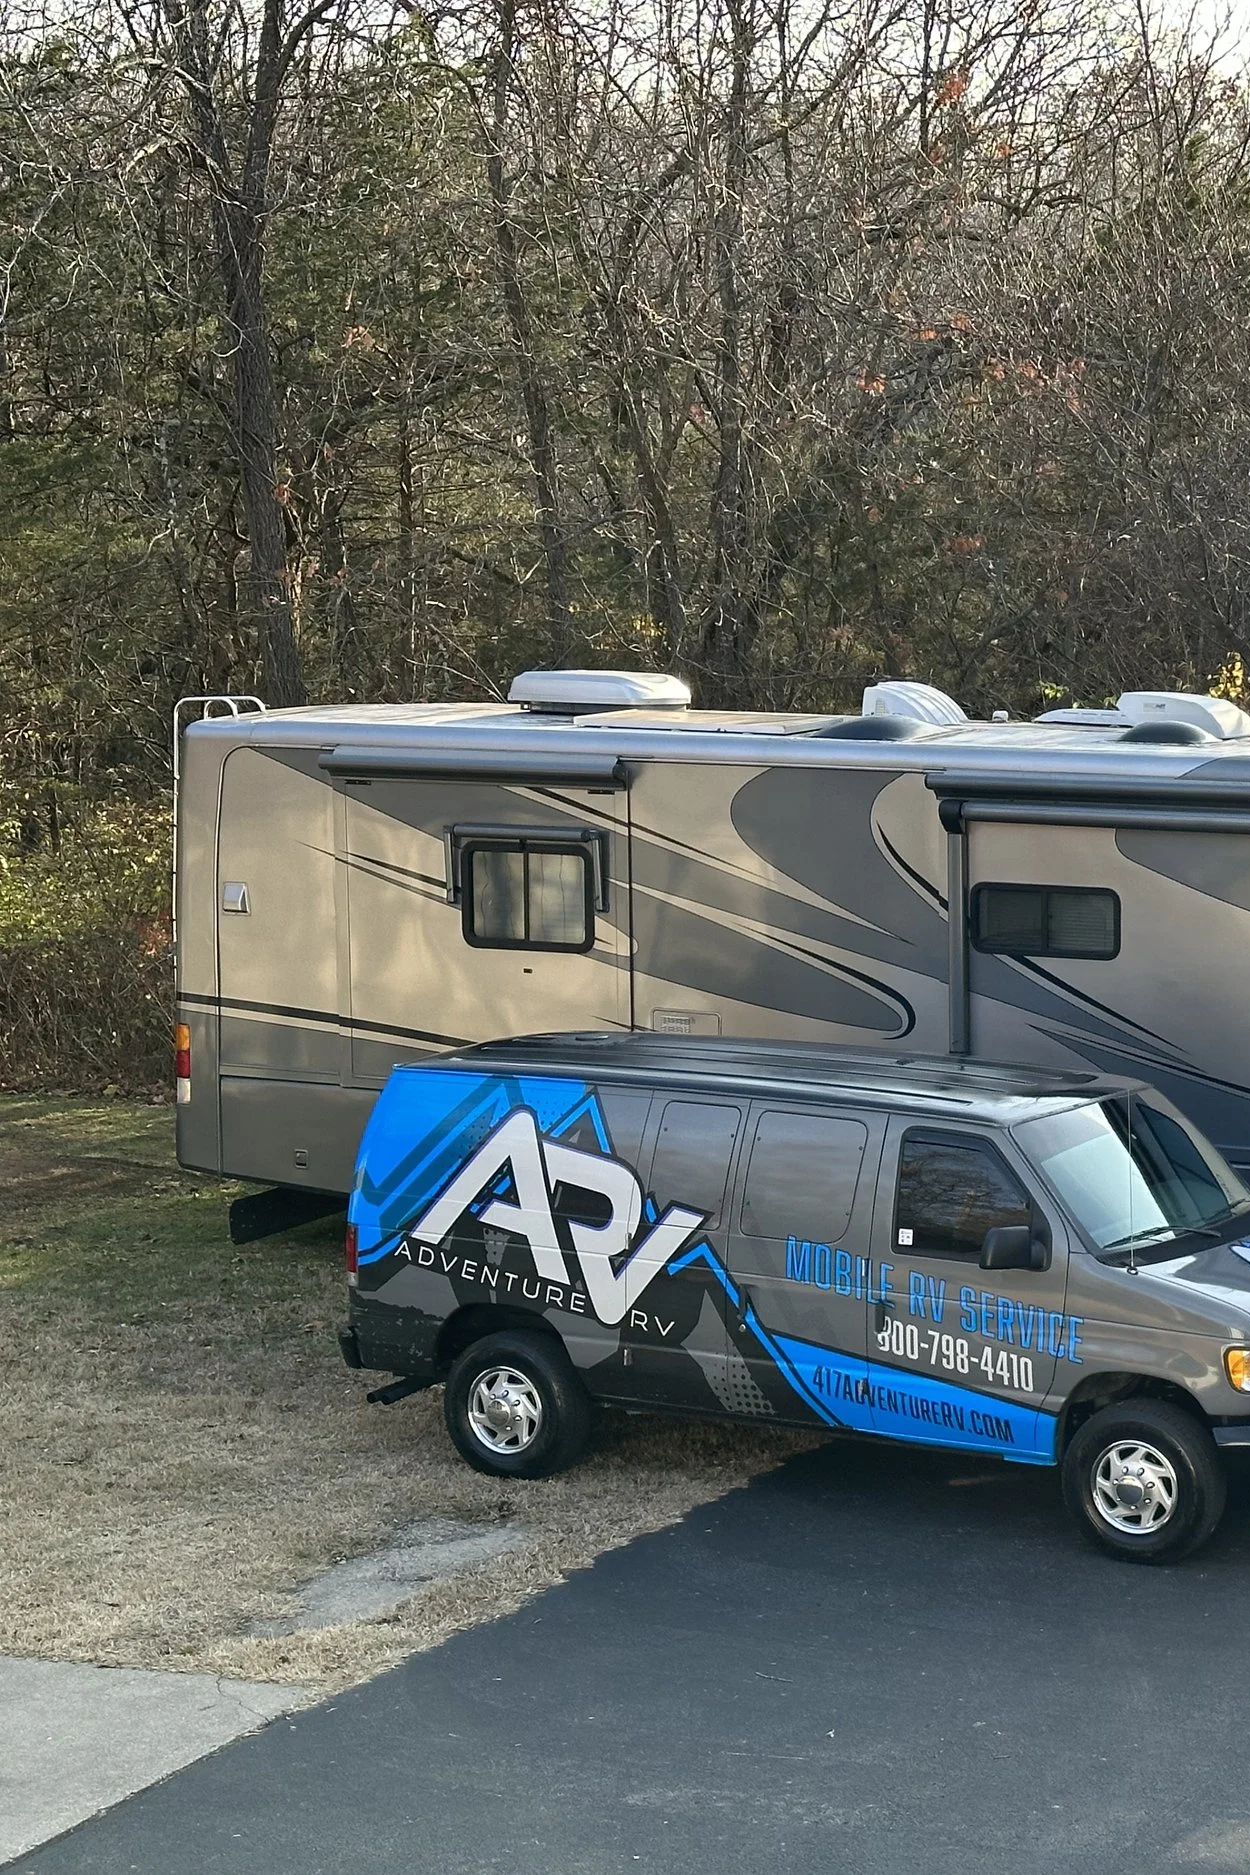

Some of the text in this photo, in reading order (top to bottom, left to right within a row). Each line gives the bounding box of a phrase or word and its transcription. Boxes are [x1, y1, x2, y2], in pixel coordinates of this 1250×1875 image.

[394, 1241, 675, 1337] ADVENTURE RV
[785, 1234, 1085, 1365] MOBILE RV SERVICE
[877, 1315, 1034, 1393] 800-798-4410
